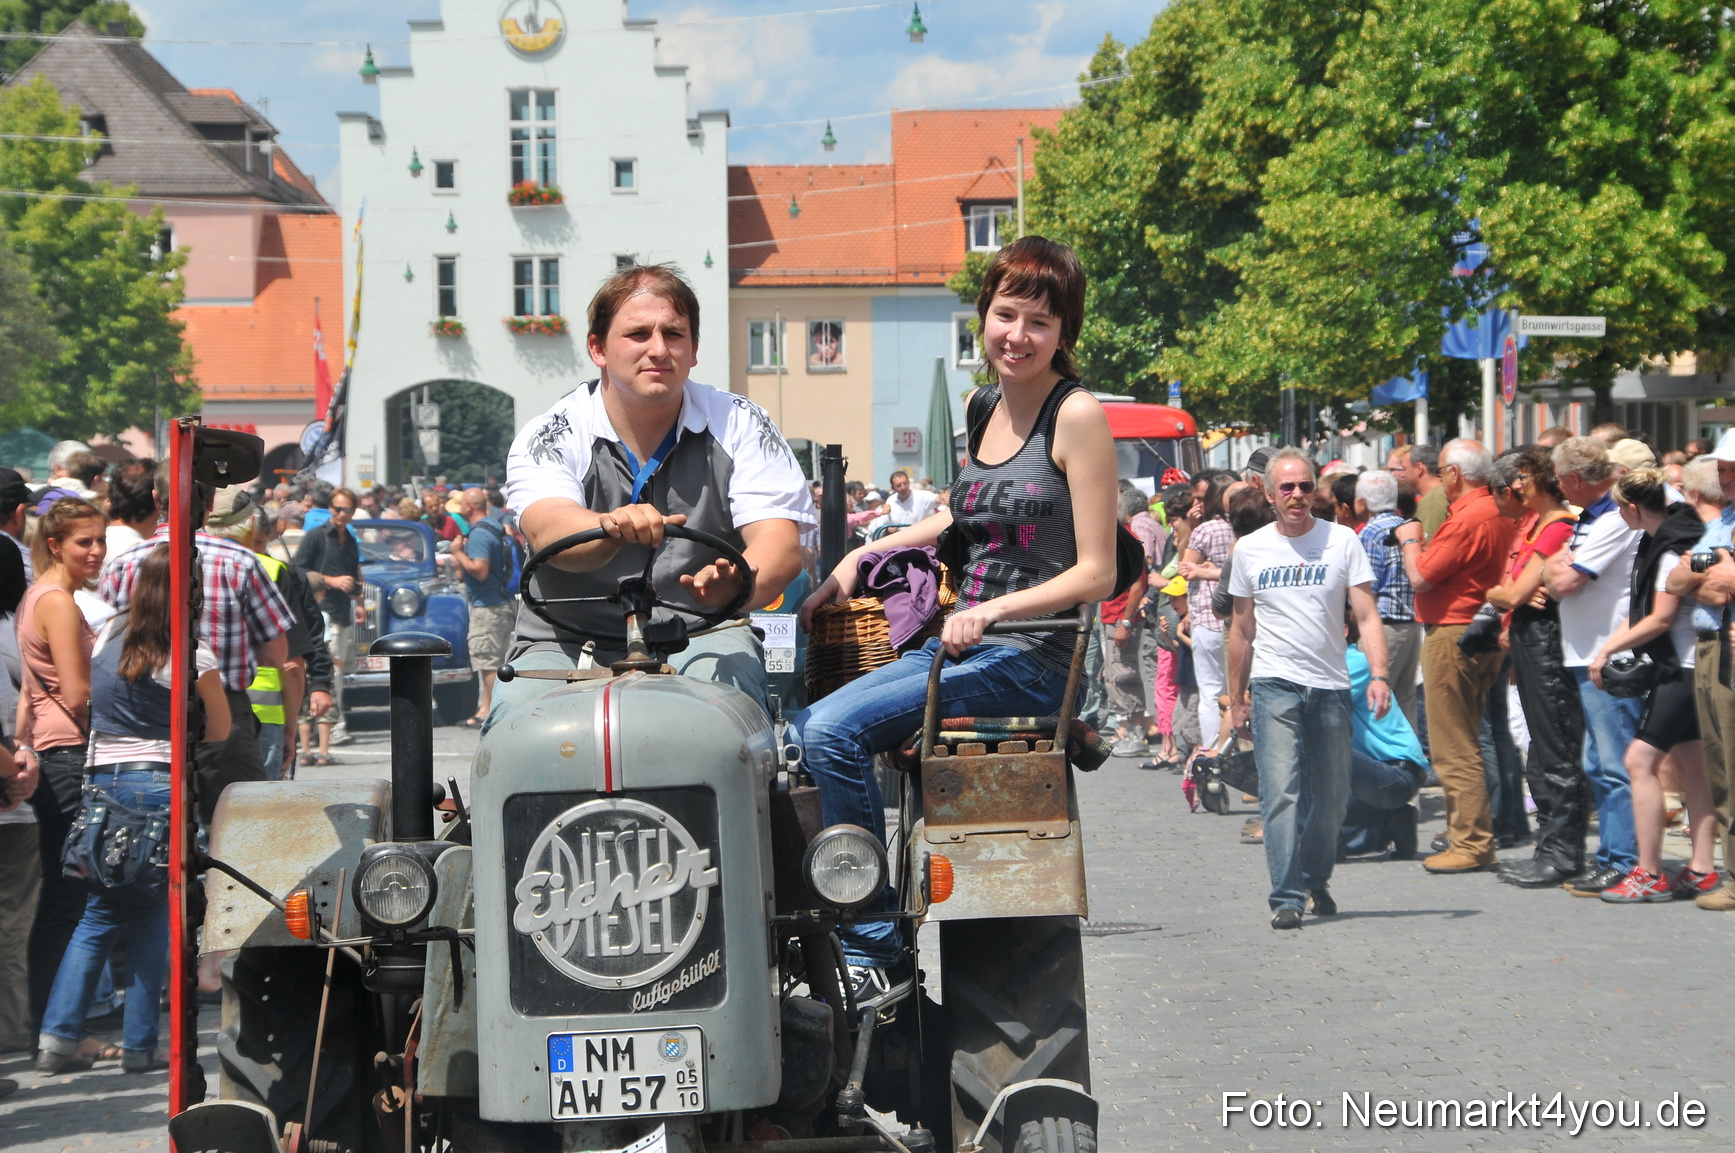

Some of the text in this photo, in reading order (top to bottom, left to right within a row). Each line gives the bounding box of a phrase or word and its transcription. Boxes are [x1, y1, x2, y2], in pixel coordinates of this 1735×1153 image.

[1522, 319, 1603, 333] Brunnwirtsgasse
[765, 623, 788, 635] 368
[769, 661, 783, 671] 55
[513, 848, 719, 936] Eicher
[632, 949, 720, 1014] luftgekühlt
[585, 1037, 635, 1073] NM
[558, 1059, 566, 1070] D
[676, 1069, 697, 1084] 05
[558, 1074, 666, 1115] AW 57
[679, 1092, 698, 1107] 10
